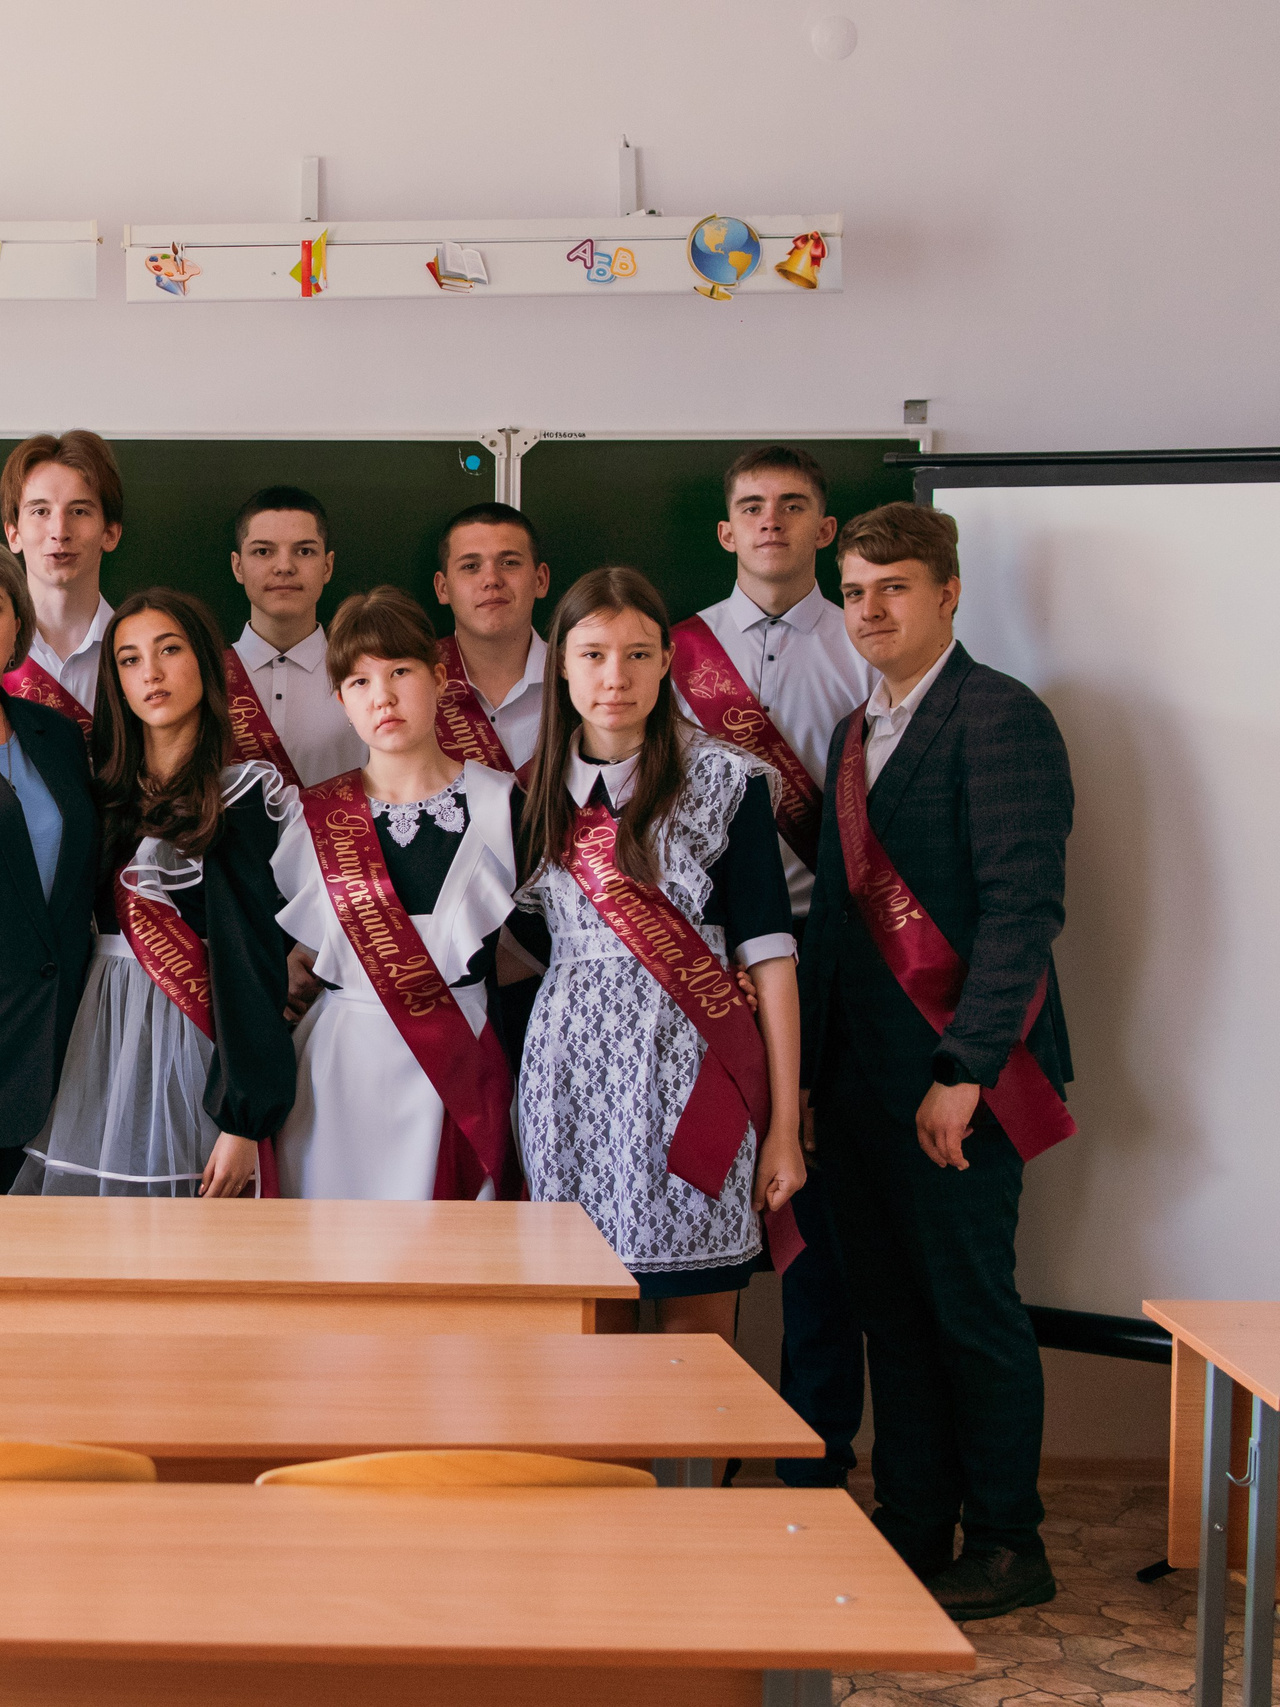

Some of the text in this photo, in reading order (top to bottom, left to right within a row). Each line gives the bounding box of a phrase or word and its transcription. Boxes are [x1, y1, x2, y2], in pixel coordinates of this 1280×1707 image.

[325, 807, 452, 1017] Выпускница 2025
[573, 825, 744, 1019] Выпускница 2025
[862, 870, 924, 933] 2025
